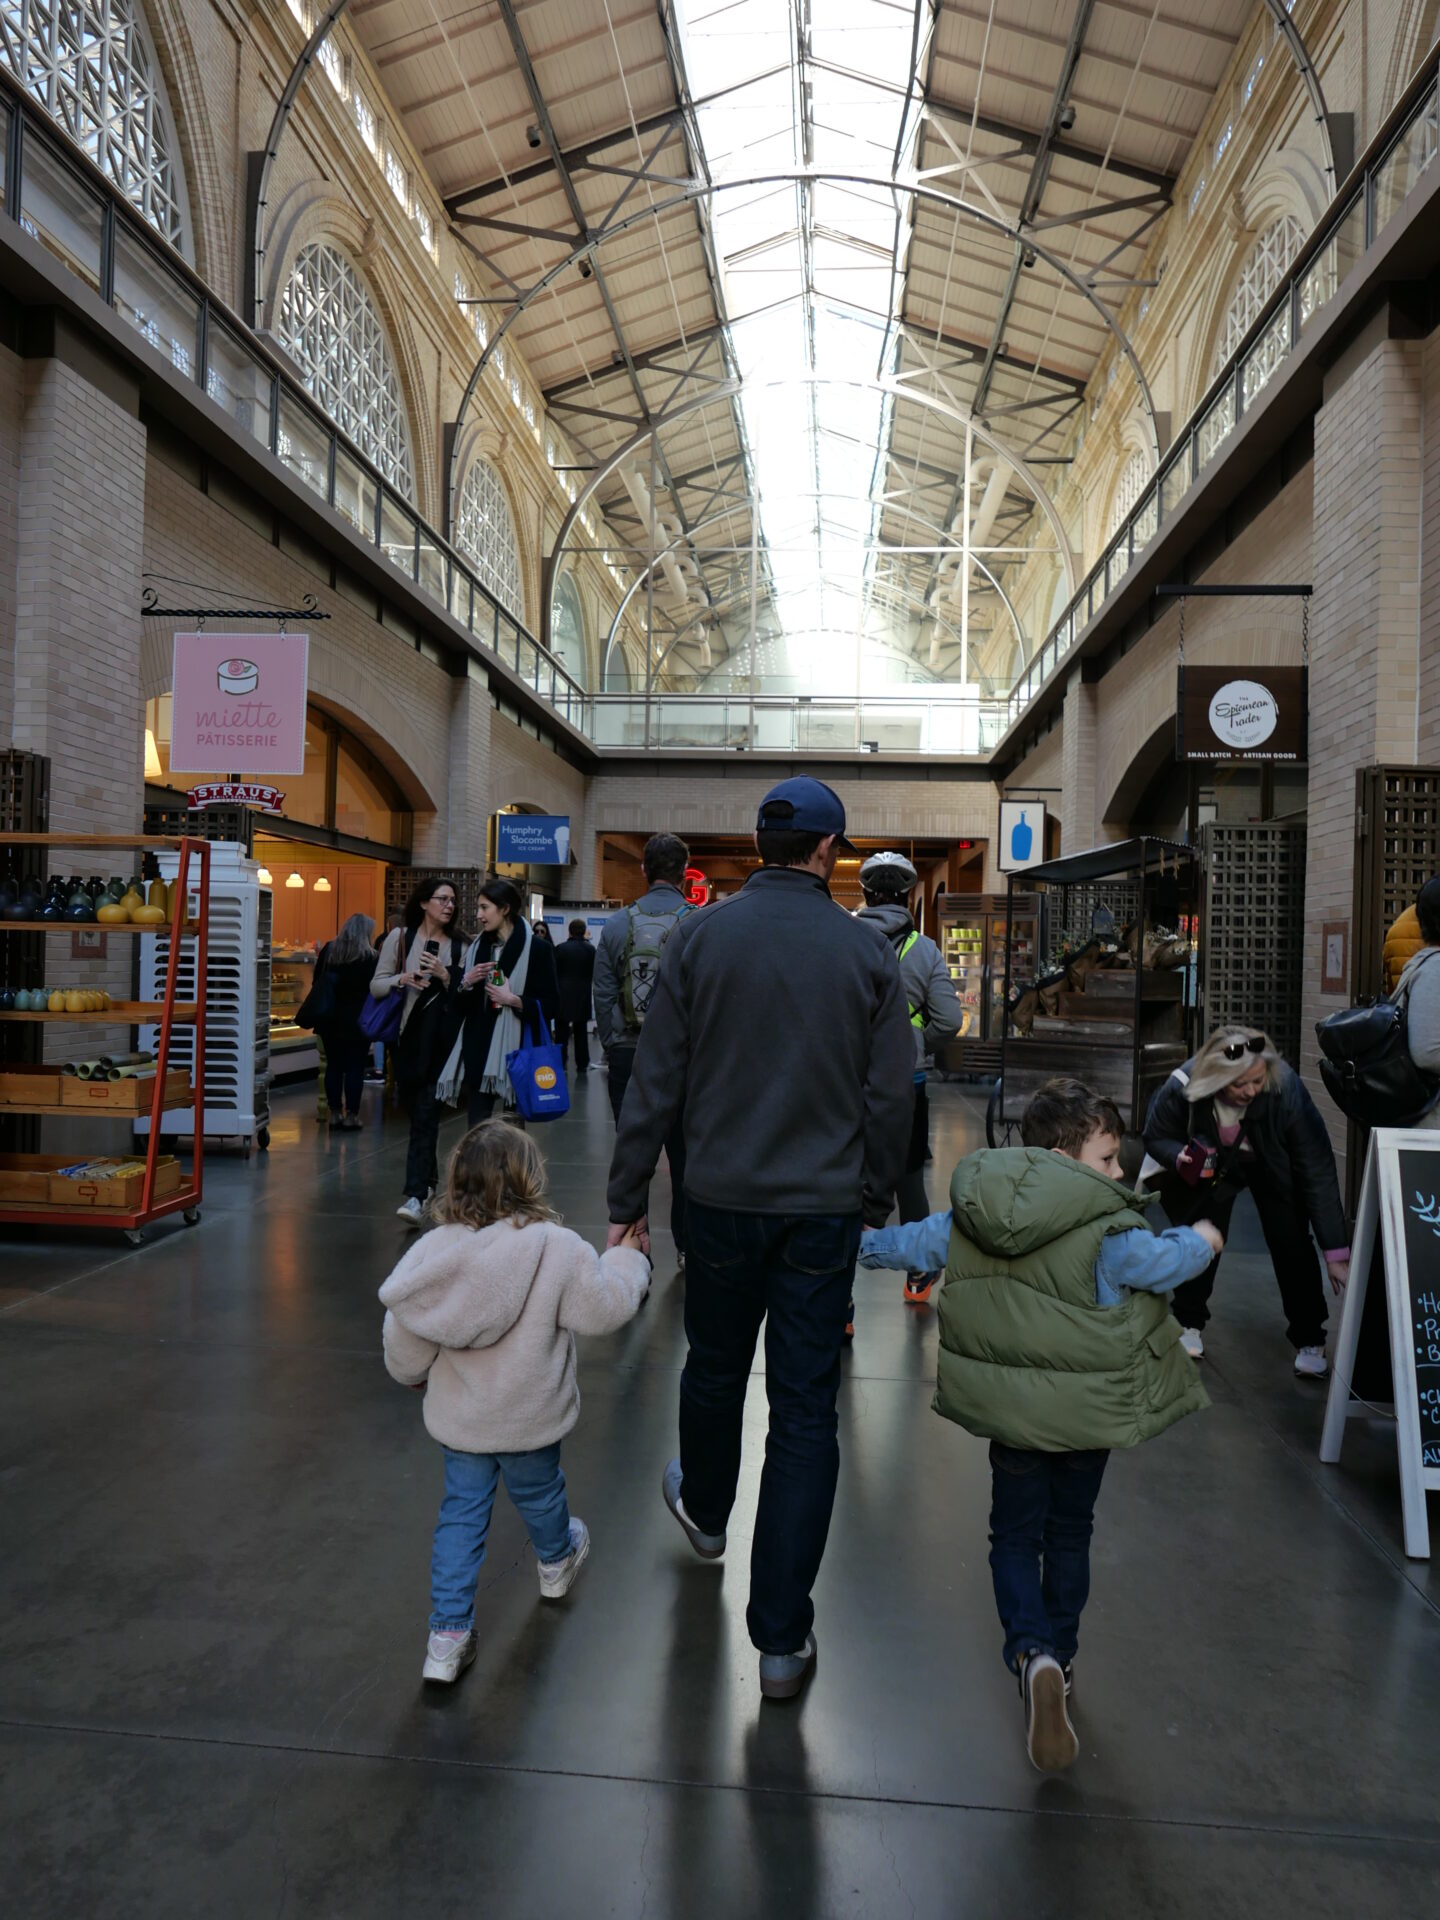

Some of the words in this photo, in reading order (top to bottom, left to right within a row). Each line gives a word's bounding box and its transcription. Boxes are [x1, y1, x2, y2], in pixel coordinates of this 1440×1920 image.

[196, 701, 282, 728] miette
[1215, 700, 1269, 717] Epicurean
[1224, 712, 1262, 728] Trader
[197, 732, 277, 747] PÂTISSERIE
[198, 786, 272, 799] STRAUS
[502, 825, 543, 836] Humphry
[511, 835, 553, 844] Slocombe
[684, 867, 707, 906] G
